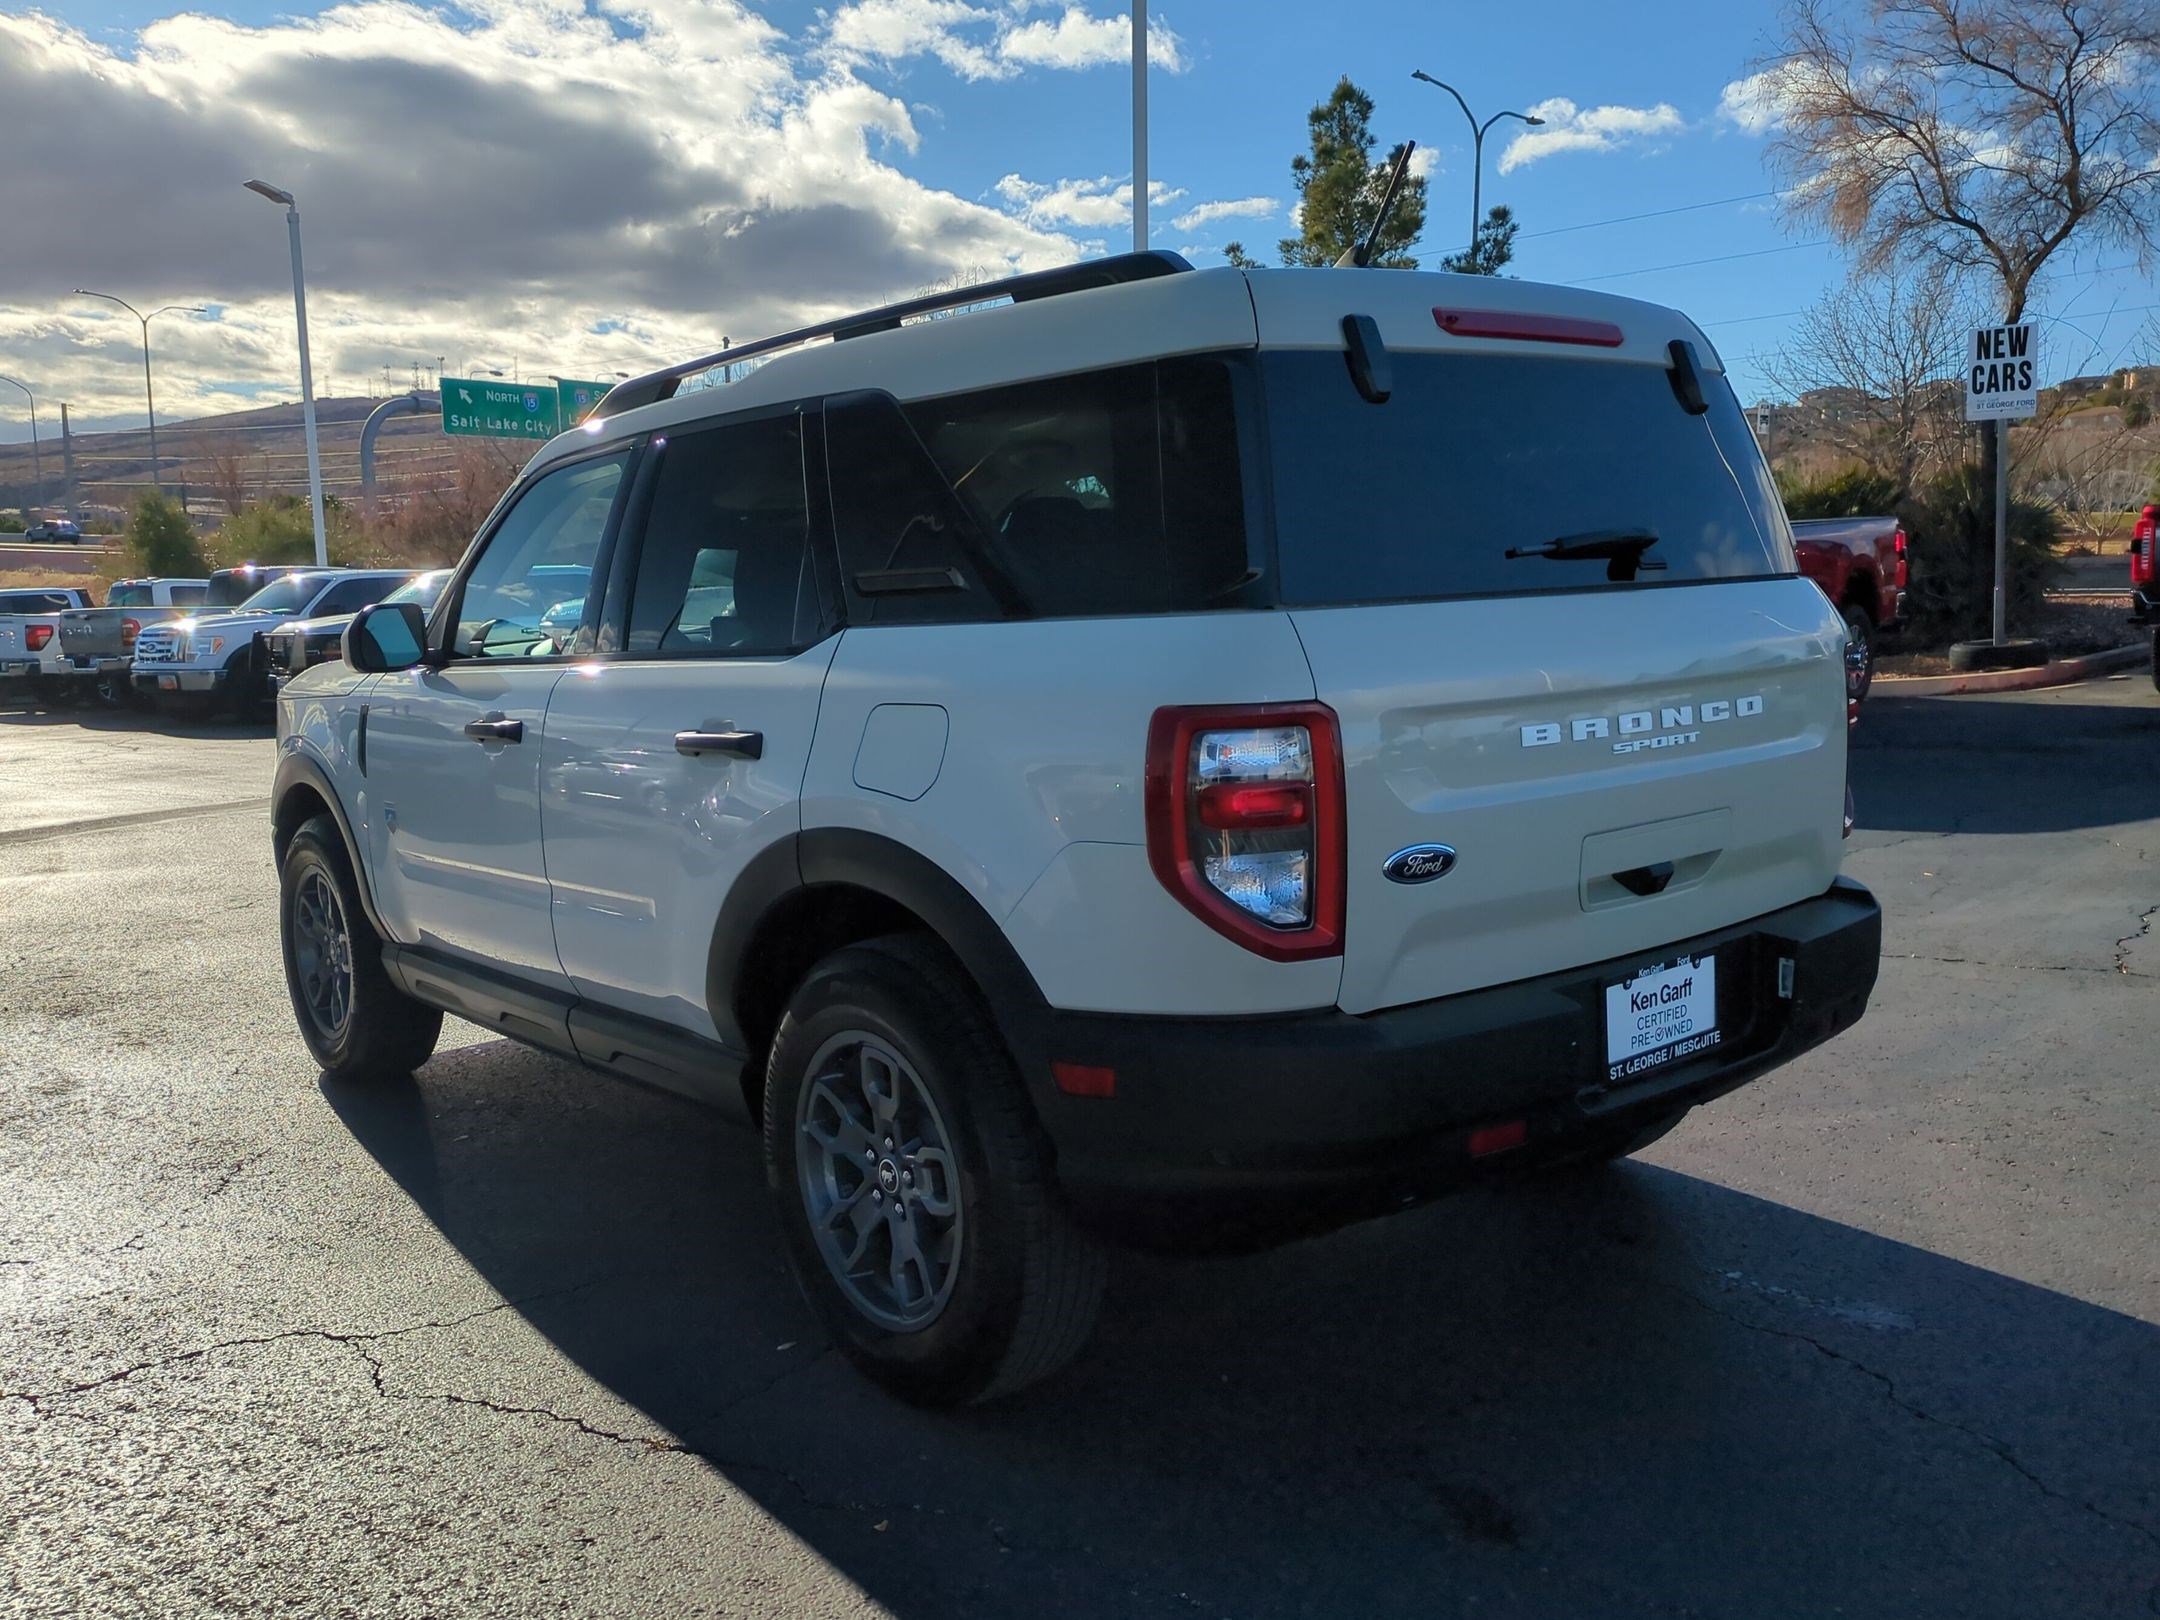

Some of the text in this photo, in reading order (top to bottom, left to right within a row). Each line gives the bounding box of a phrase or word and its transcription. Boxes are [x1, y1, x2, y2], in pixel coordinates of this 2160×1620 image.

[1976, 326, 2029, 360] NEW
[1972, 360, 2032, 395] CARS
[486, 390, 536, 408] NORTH 15
[578, 393, 586, 403] 15
[1986, 400, 2015, 409] GEORGE
[2016, 399, 2036, 407] FORD
[450, 414, 552, 436] Salt Lake City
[1520, 695, 1764, 748] BRONCO
[1611, 730, 1701, 755] SPORT
[1403, 852, 1444, 875] Ford
[1630, 977, 1693, 1014] Ken Garff
[1636, 1004, 1688, 1031] CERTIFIED
[1609, 1062, 1625, 1081] ST.
[1626, 1046, 1668, 1075] GEORGE
[1674, 1030, 1721, 1058] MESQUITE
